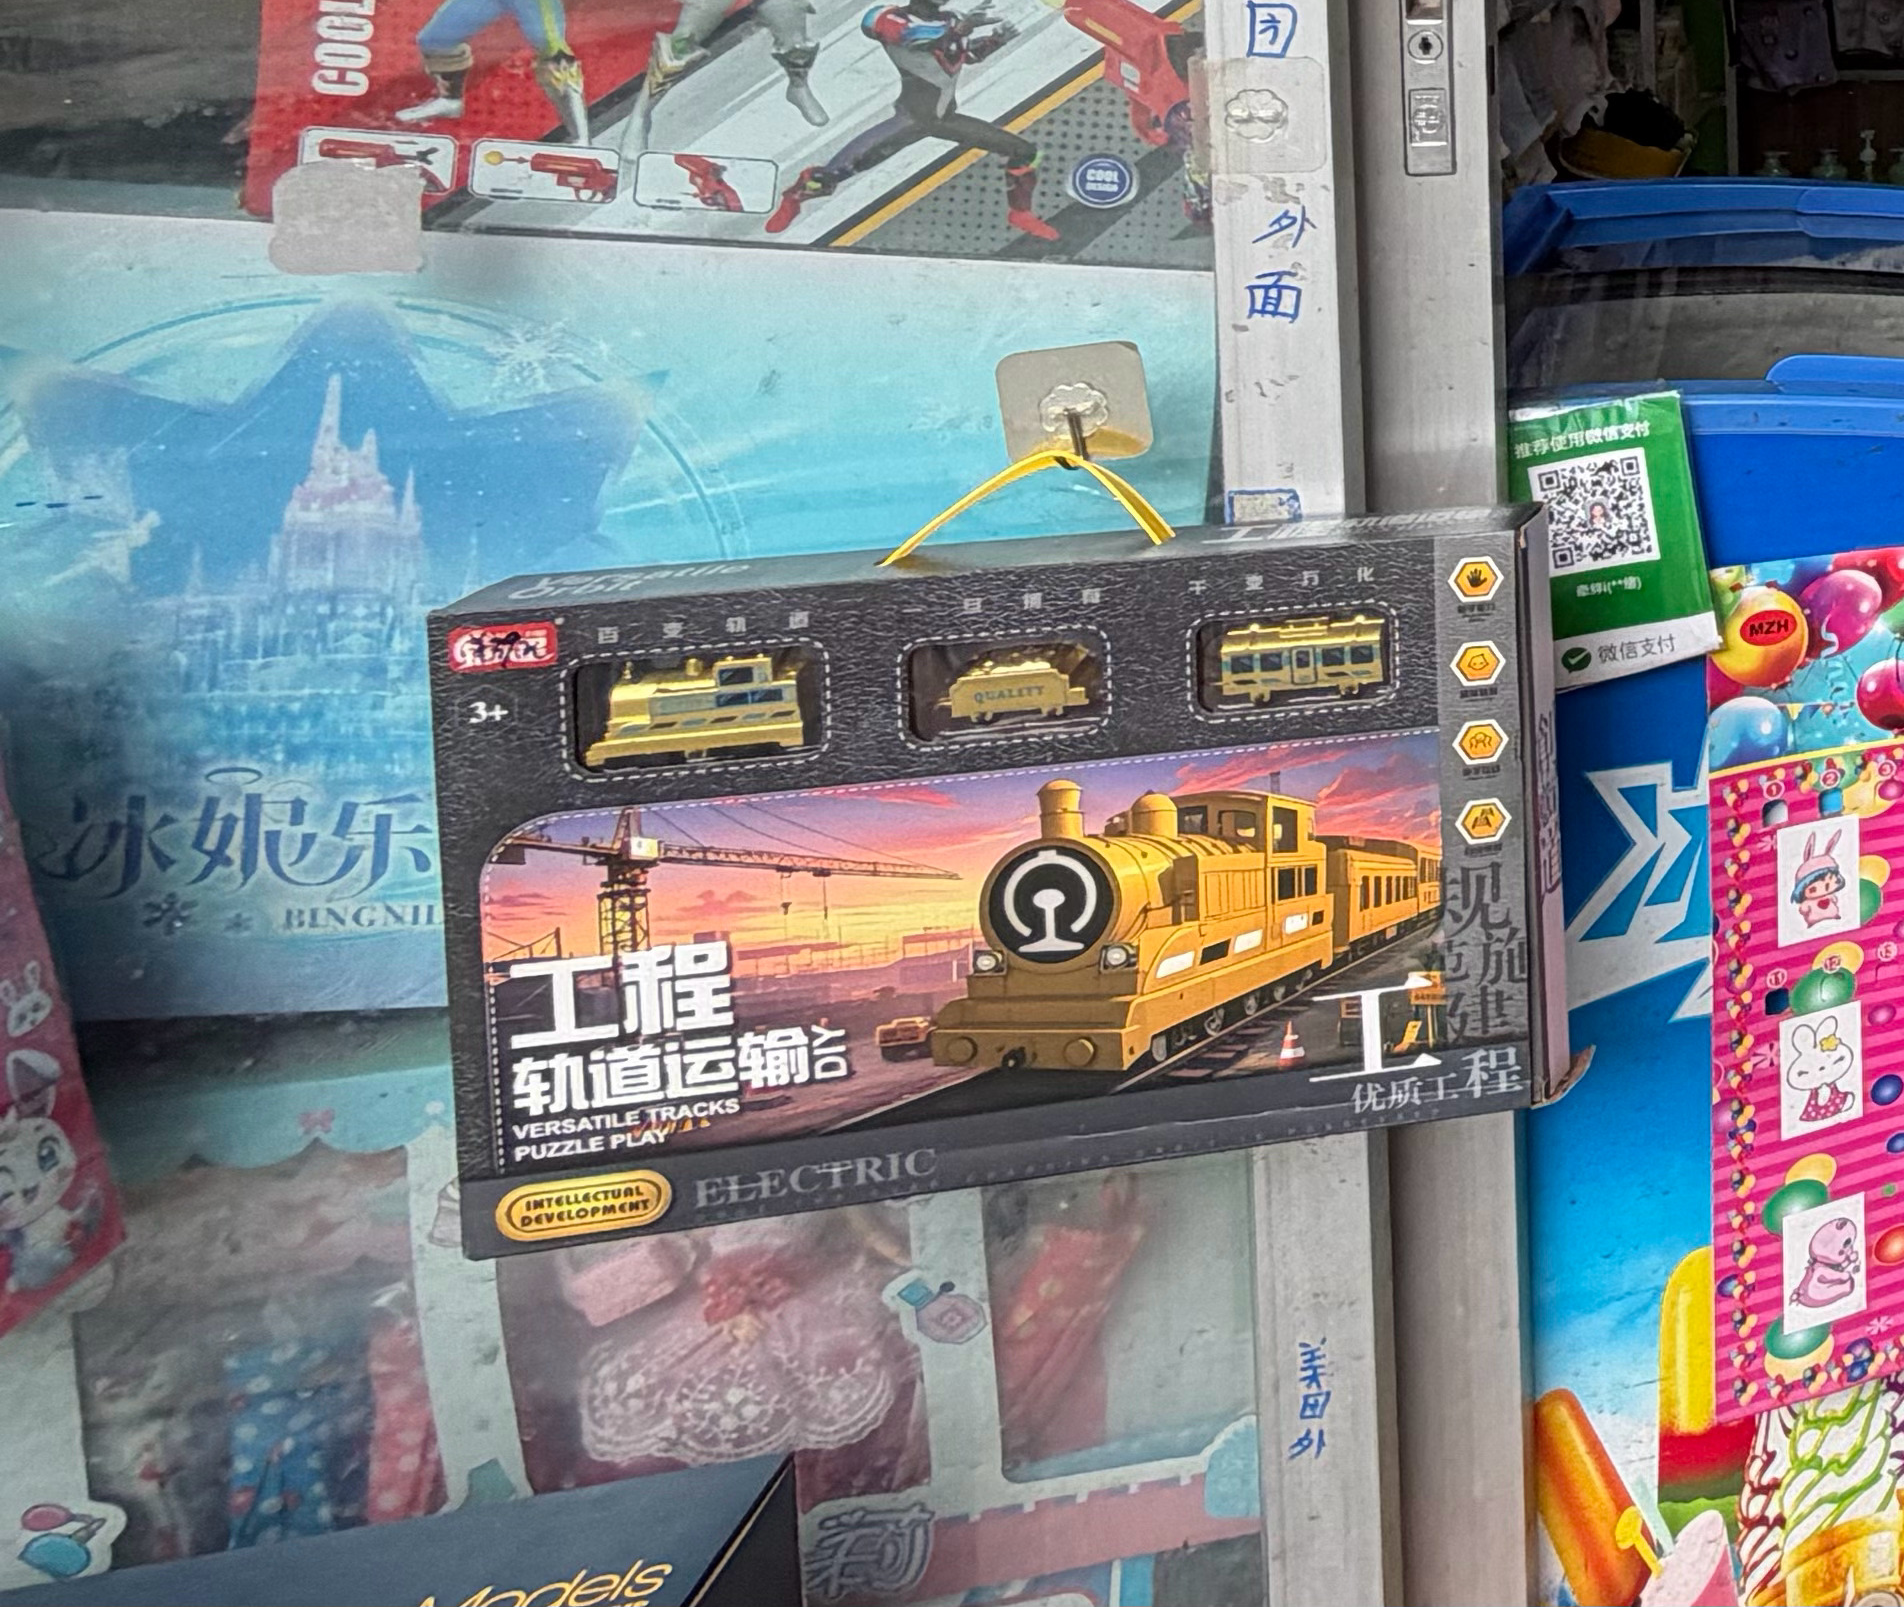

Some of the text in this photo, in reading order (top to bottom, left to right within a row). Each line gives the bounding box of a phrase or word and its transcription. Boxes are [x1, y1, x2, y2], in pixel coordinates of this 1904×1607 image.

[313, 3, 371, 96] COOL
[1086, 168, 1120, 183] COOL
[1513, 420, 1651, 459] 推荐使用微信支付
[1748, 618, 1791, 638] MZH
[1598, 634, 1676, 664] 微信支付
[468, 700, 509, 725] 3+
[509, 938, 735, 1051] 工程
[811, 1023, 848, 1080] DIY
[511, 1028, 810, 1117] 轨道运输
[1351, 1045, 1525, 1114] 优质工程
[512, 1097, 742, 1141] VERSATILE TRACKS
[513, 1126, 671, 1162] PUZZLE PLAY
[694, 1147, 939, 1210] ELECTRIC
[519, 1199, 651, 1228] DEVELOPMENT
[524, 1184, 645, 1213] INTELLECTUAL
